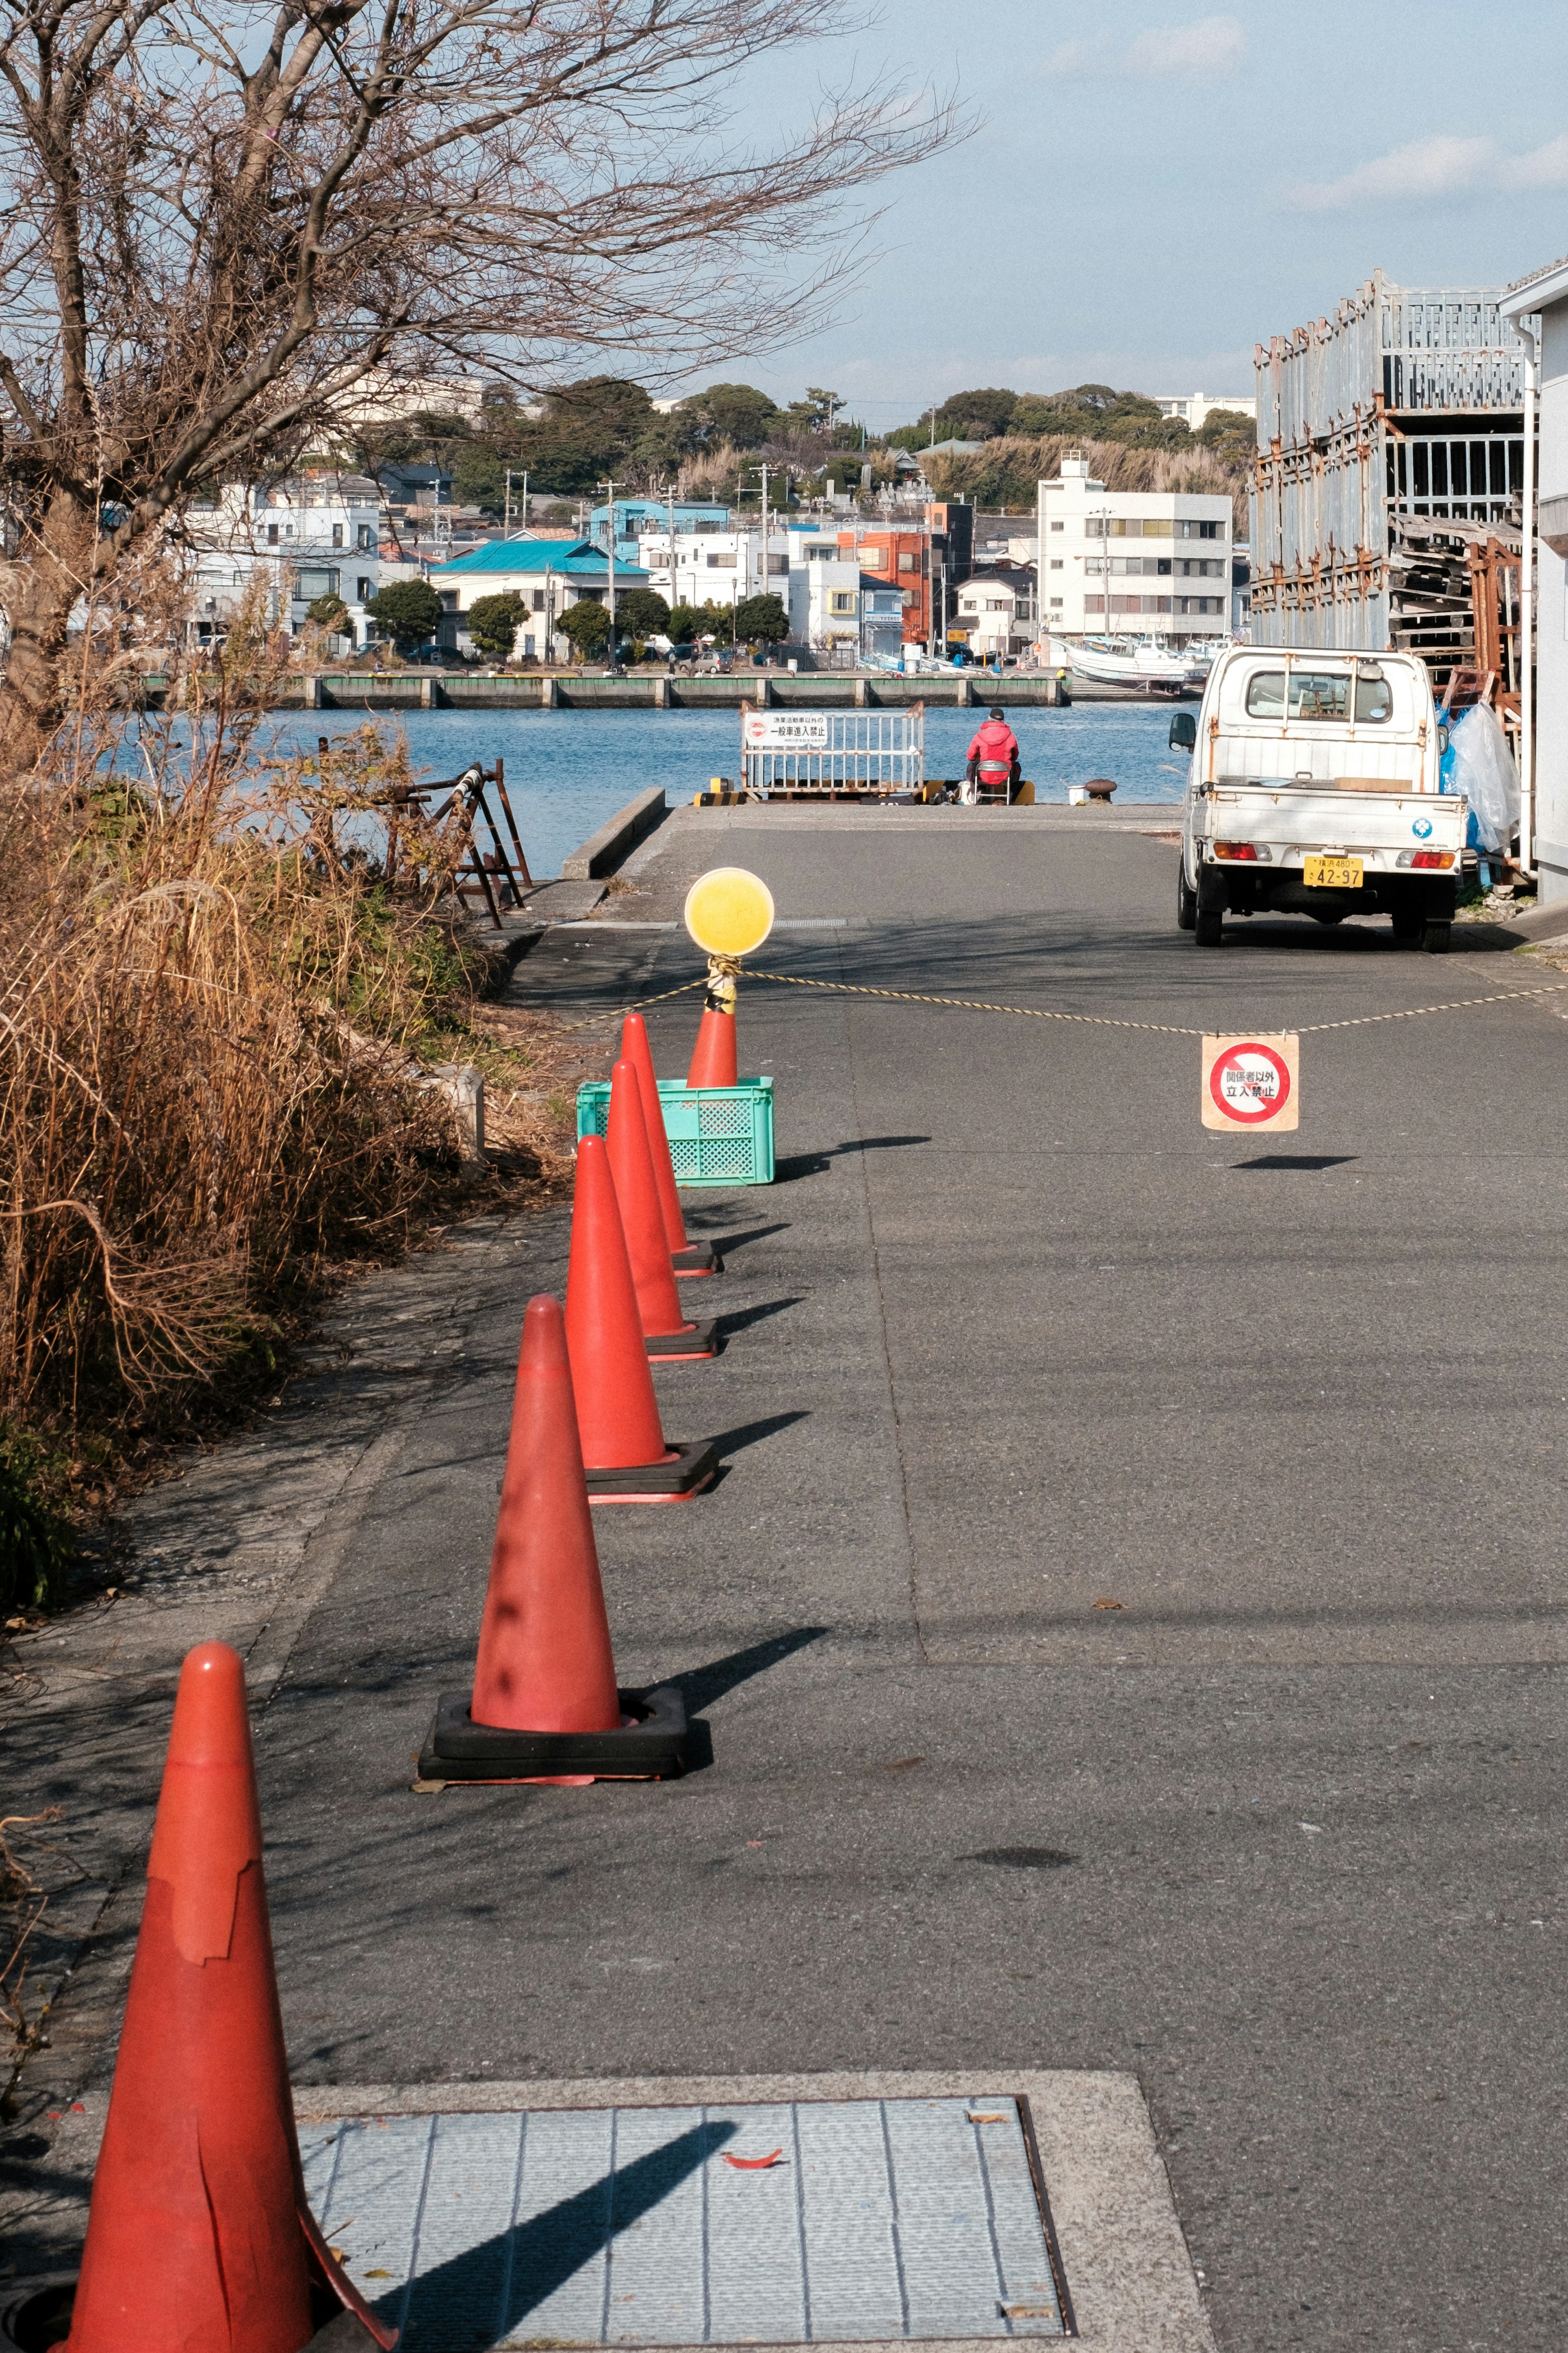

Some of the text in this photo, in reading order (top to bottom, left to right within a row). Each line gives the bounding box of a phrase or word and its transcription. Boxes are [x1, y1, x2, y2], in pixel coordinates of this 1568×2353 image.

[771, 726, 825, 736] 一般車進入禁止
[1317, 869, 1359, 885] 42-97
[1227, 1071, 1274, 1082] 関係者以外
[1226, 1086, 1274, 1097] 立入禁止
